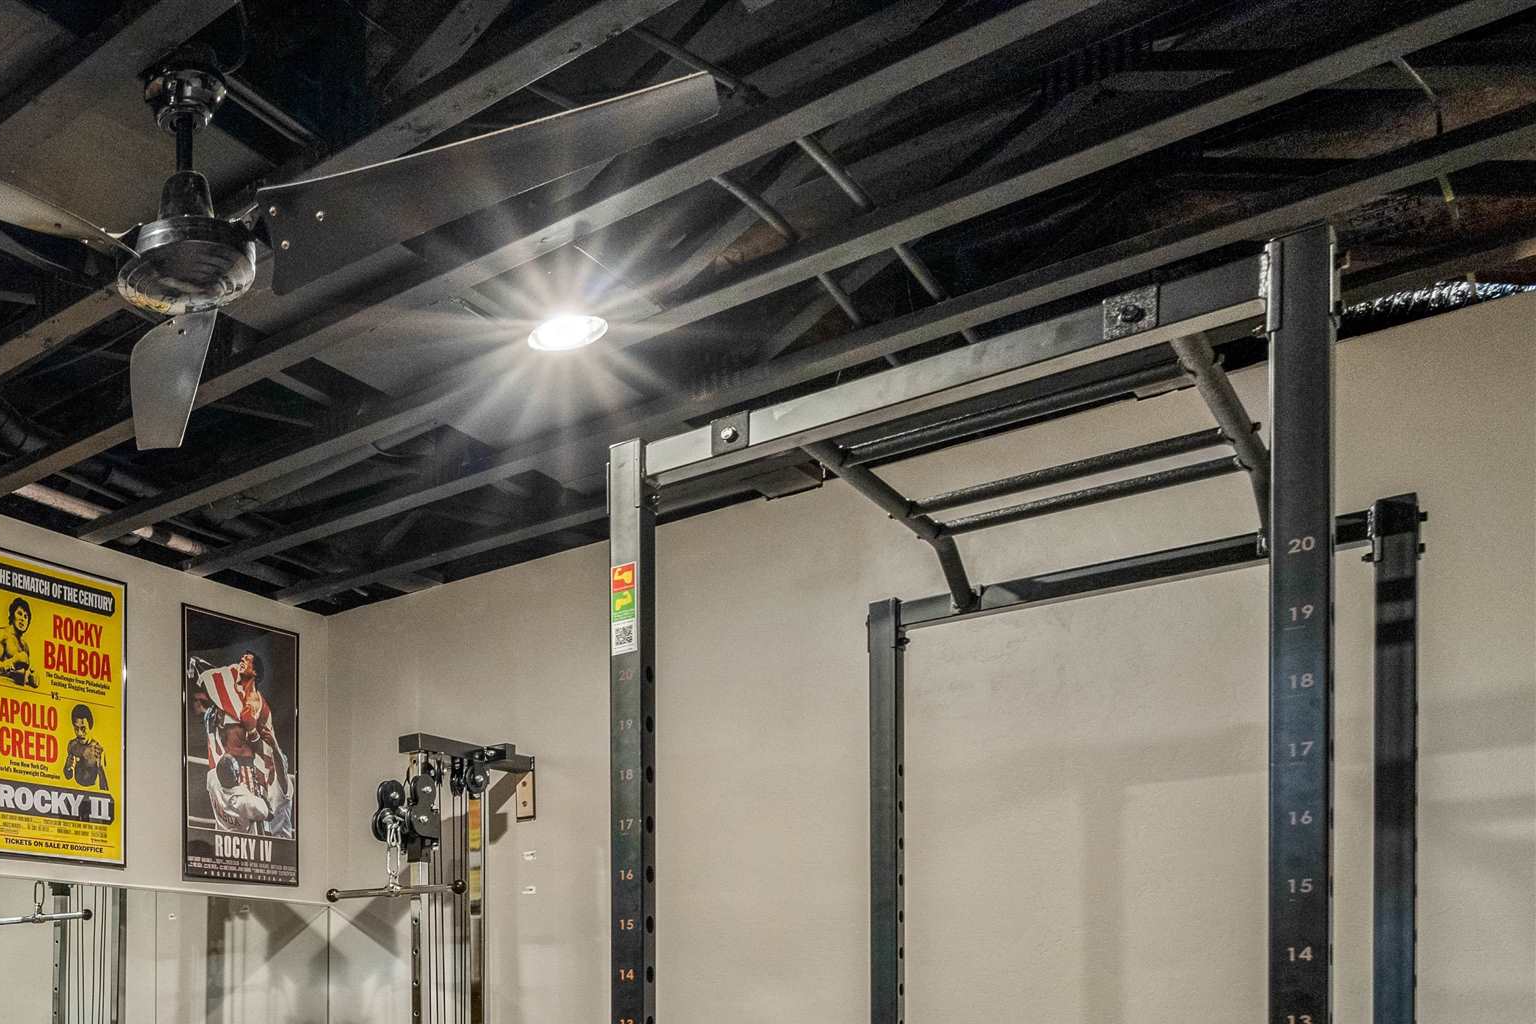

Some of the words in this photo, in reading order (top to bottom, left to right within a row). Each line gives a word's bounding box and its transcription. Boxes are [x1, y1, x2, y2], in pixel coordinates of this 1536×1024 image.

[1288, 536, 1315, 554] 20
[12, 572, 50, 597] REMATCH
[52, 582, 62, 599] OF
[63, 585, 78, 603] THE
[78, 588, 113, 612] CENTURY
[1288, 604, 1314, 621] 19
[52, 613, 103, 649] ROCKY
[44, 640, 112, 682] BALBOA
[1288, 673, 1314, 688] 18
[0, 697, 58, 731] APOLLO
[1289, 741, 1314, 757] 17
[620, 769, 633, 780] 18
[88, 796, 112, 821] II
[620, 819, 634, 831] 17
[1288, 810, 1313, 825] 16
[5, 837, 32, 847] TICKETS
[33, 840, 43, 848] ON
[44, 841, 61, 850] SALE
[214, 834, 256, 861] ROCKY
[259, 839, 272, 863] IV
[620, 869, 634, 881] 16
[1288, 878, 1313, 894] 15
[620, 919, 634, 931] 15
[1287, 946, 1313, 962] 14
[620, 969, 635, 981] 14
